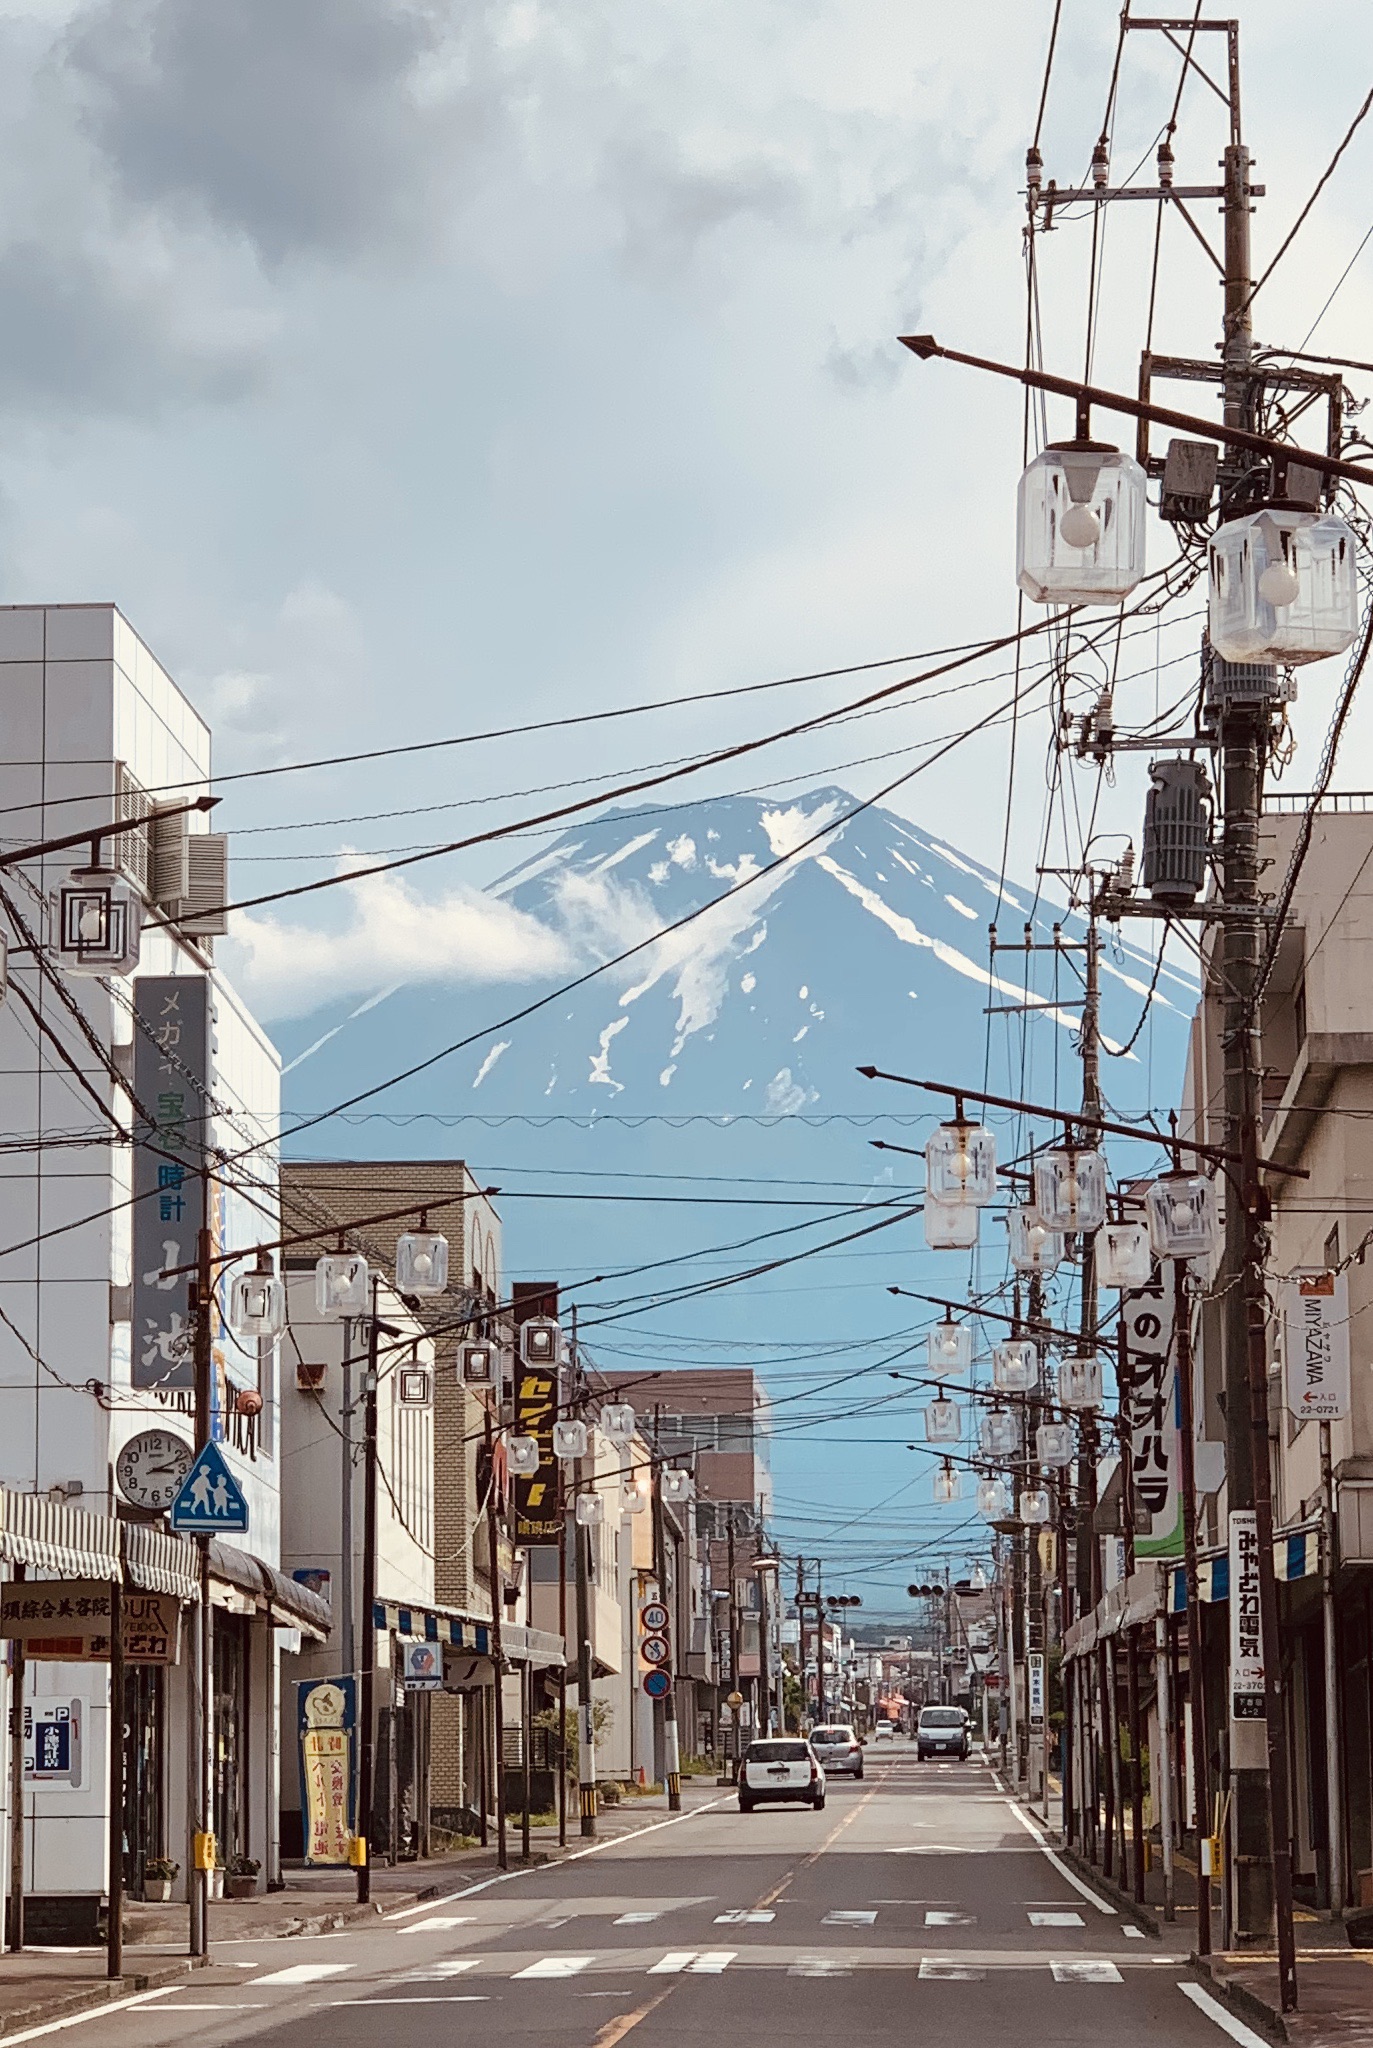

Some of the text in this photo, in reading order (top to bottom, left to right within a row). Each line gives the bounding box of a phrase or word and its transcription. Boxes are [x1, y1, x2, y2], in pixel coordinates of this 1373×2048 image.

[1304, 1299, 1323, 1386] MIYAZAWA
[1319, 1392, 1336, 1401] 入口
[1300, 1405, 1339, 1414] 22-0721
[137, 1440, 147, 1453] 11
[150, 1438, 161, 1450] 12
[167, 1440, 171, 1452] 1
[125, 1452, 139, 1463] 10
[124, 1465, 133, 1477] 9
[178, 1463, 187, 1474] 3
[129, 1477, 138, 1489] 8
[174, 1476, 183, 1486] 4
[139, 1488, 147, 1498] 7
[151, 1490, 160, 1502] 6
[165, 1487, 174, 1498] 5
[1238, 1530, 1260, 1658] みやざわ電気
[647, 1611, 664, 1624] 40
[90, 1635, 167, 1655] みざわ
[1234, 1668, 1250, 1678] 入口
[1233, 1681, 1265, 1690] 22-370
[1241, 1707, 1259, 1717] 4-2
